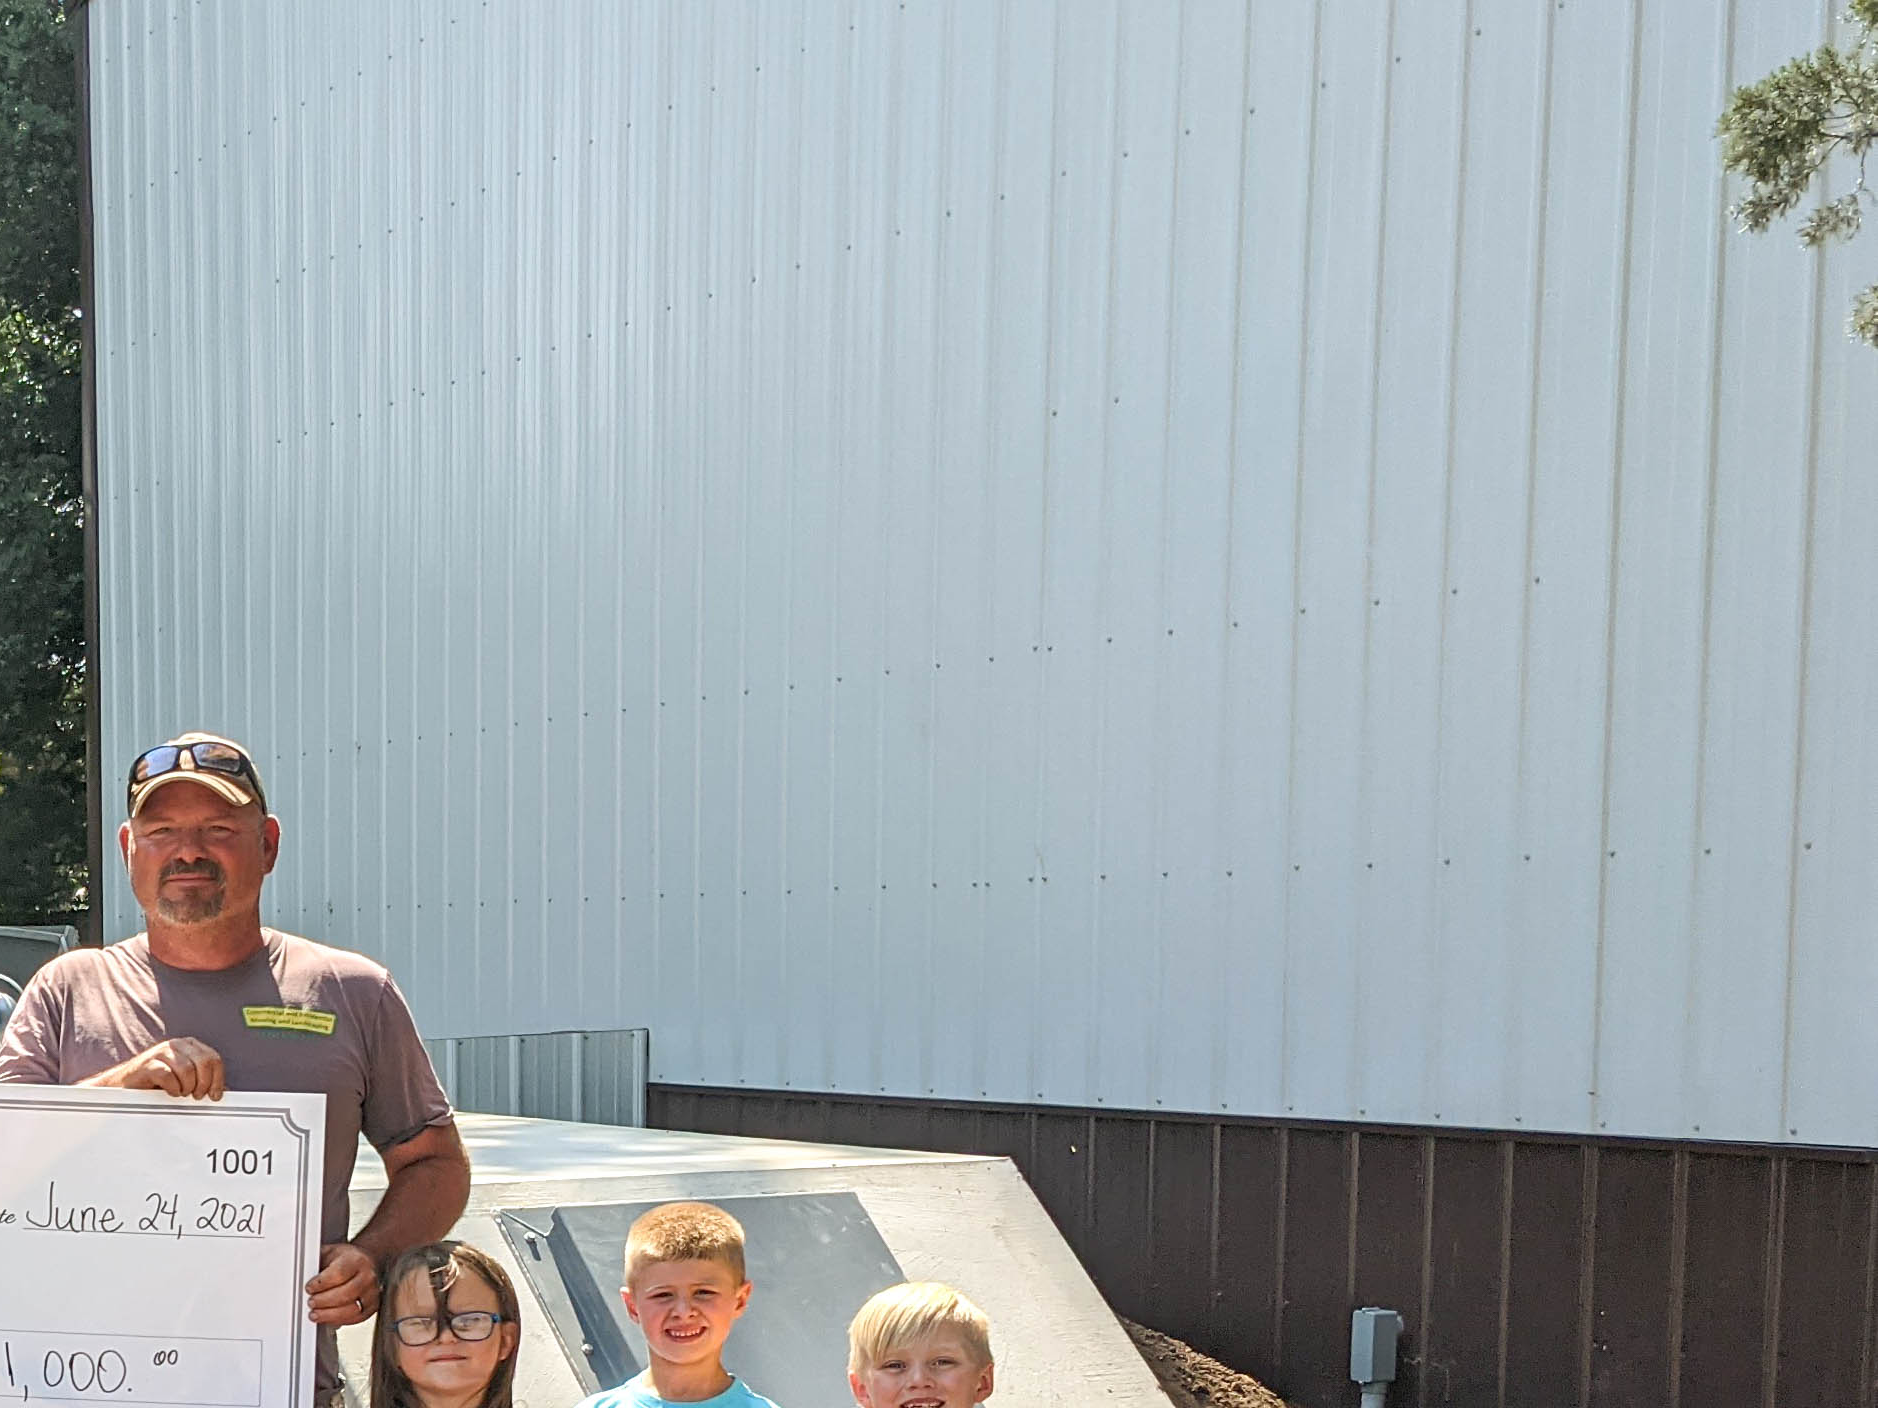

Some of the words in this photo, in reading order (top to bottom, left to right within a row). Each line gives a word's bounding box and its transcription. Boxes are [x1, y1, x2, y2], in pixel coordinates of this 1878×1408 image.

[206, 1148, 274, 1176] 1001
[25, 1180, 125, 1233] June
[138, 1192, 184, 1240] 24,
[196, 1196, 264, 1236] 2021
